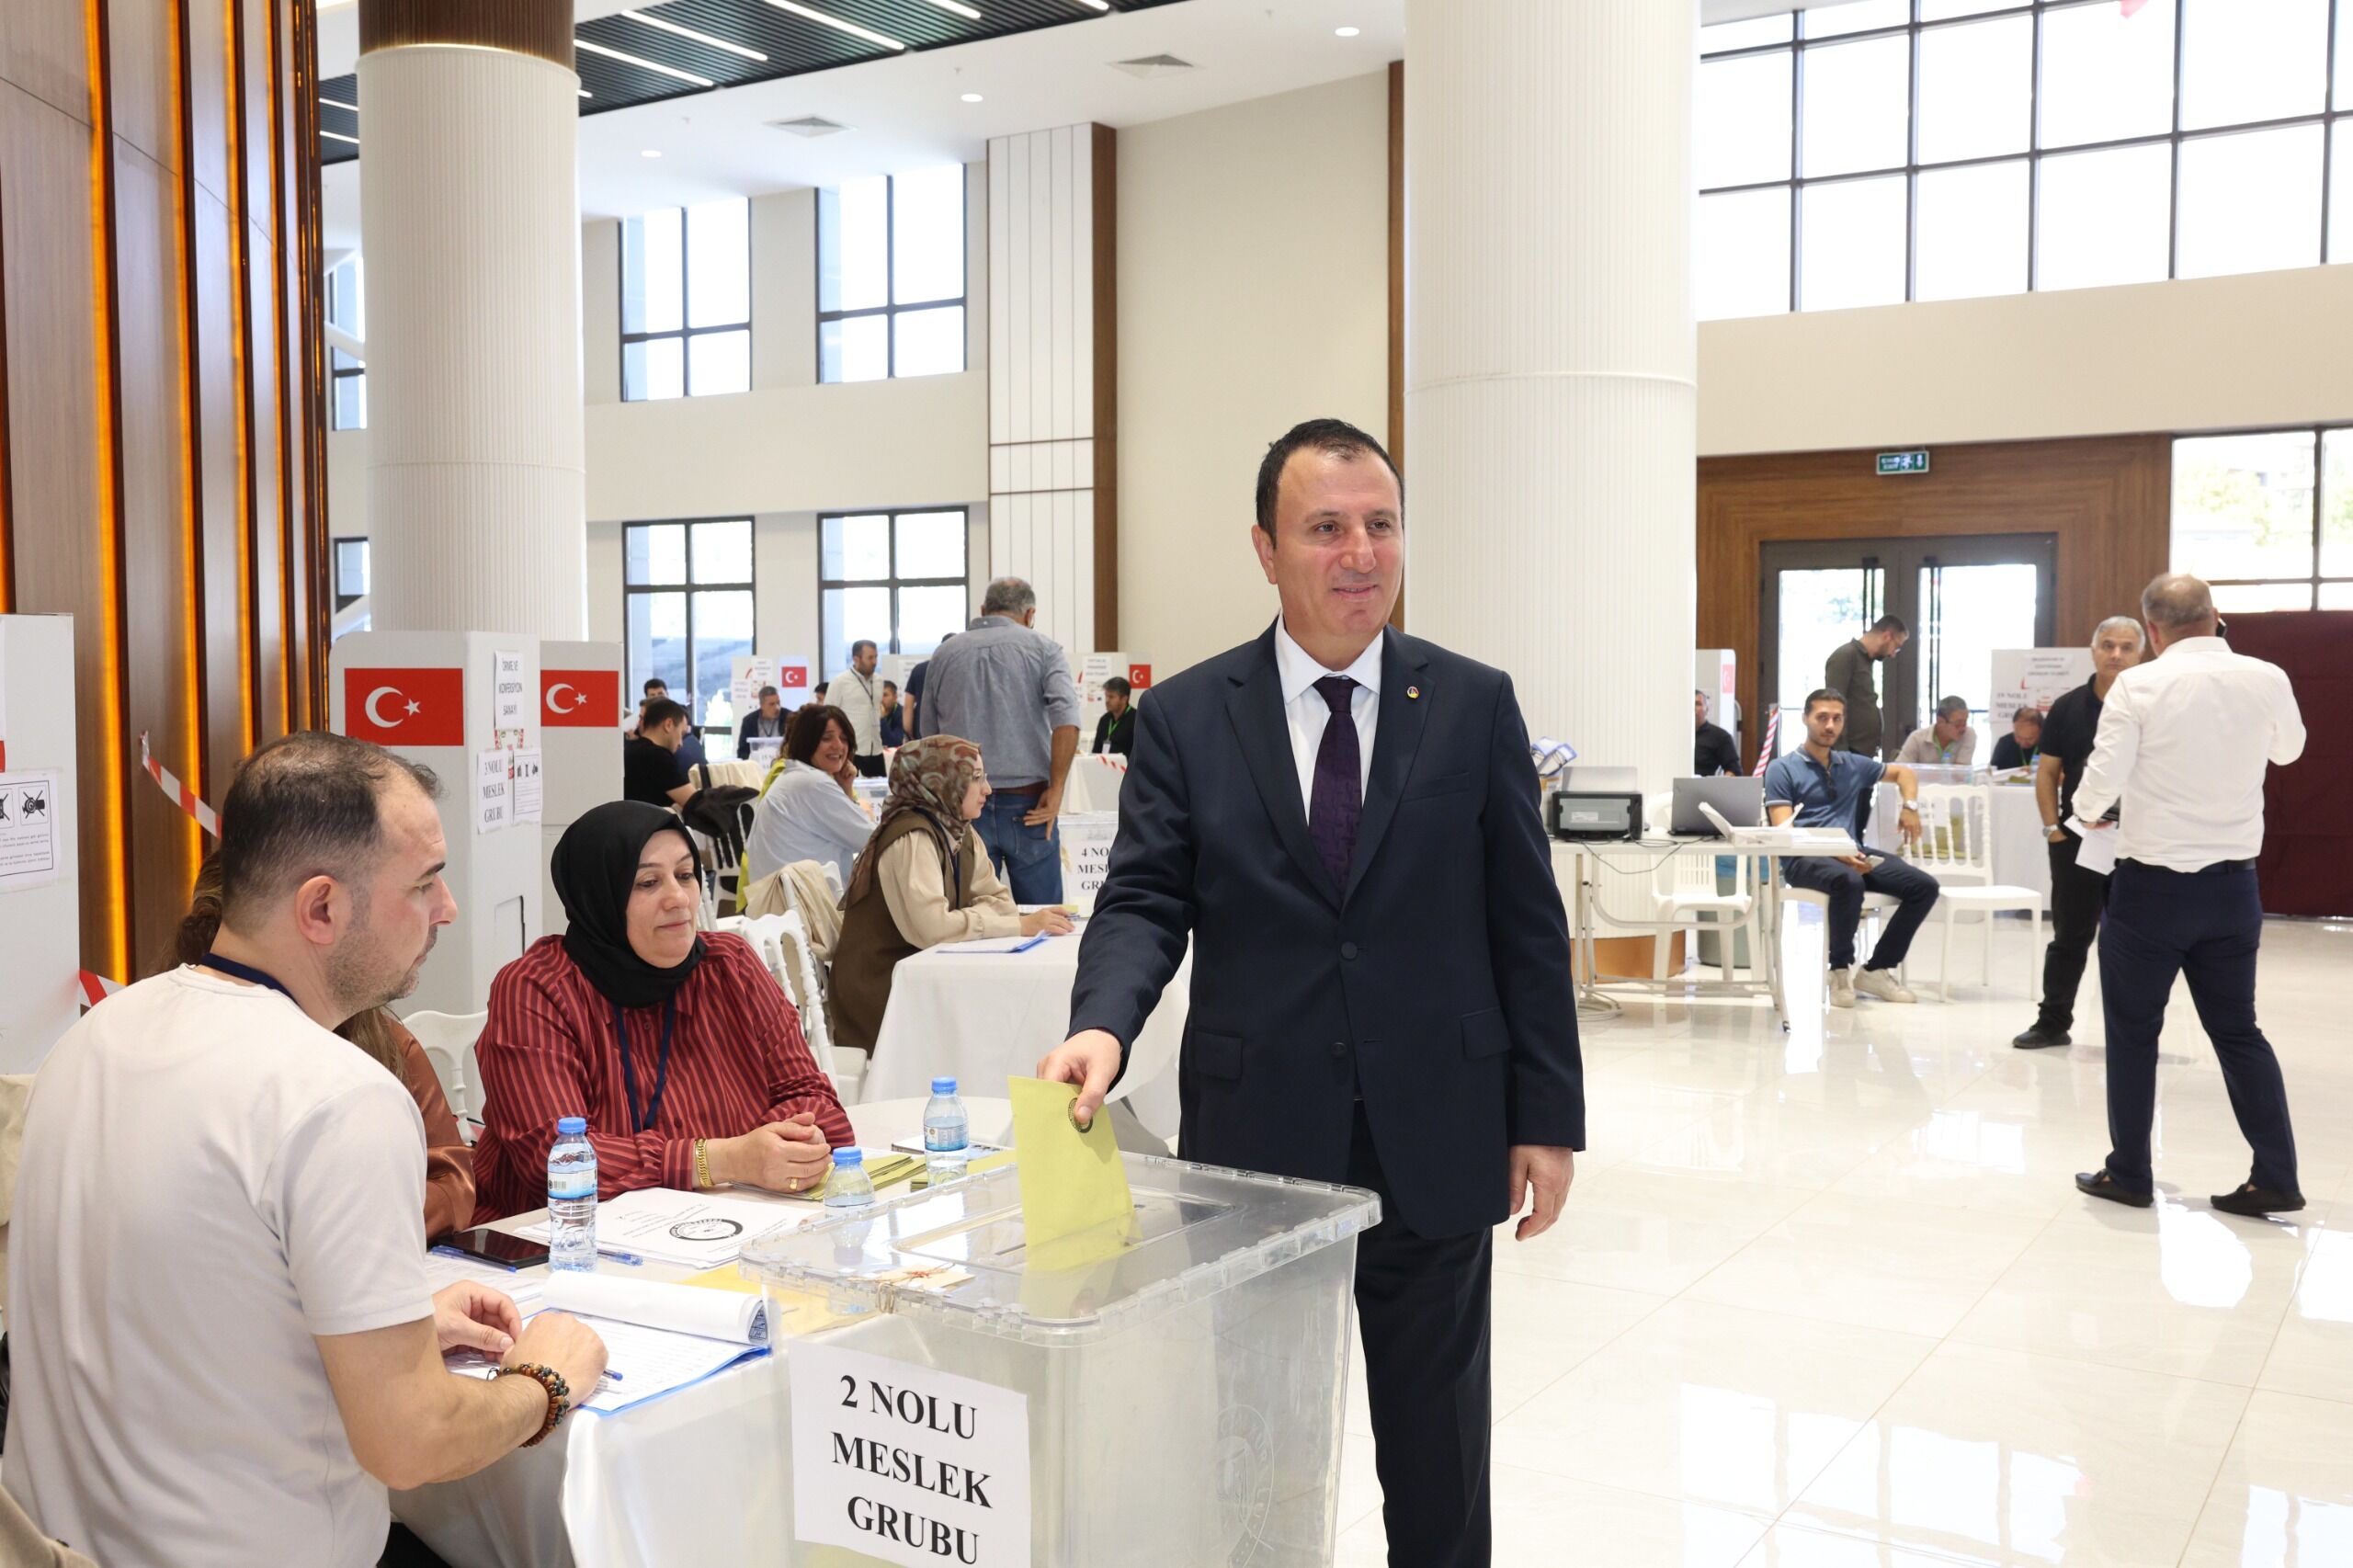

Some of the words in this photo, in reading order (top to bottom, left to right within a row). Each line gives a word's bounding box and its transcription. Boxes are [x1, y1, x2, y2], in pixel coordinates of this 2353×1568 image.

[483, 783, 506, 800] MESLEK
[1081, 847, 1087, 857] 4
[1091, 846, 1109, 857] NO
[840, 1375, 858, 1408] 2
[868, 1380, 977, 1439] NOLU
[831, 1431, 993, 1508] MESLEK
[847, 1495, 980, 1565] GRUBU
